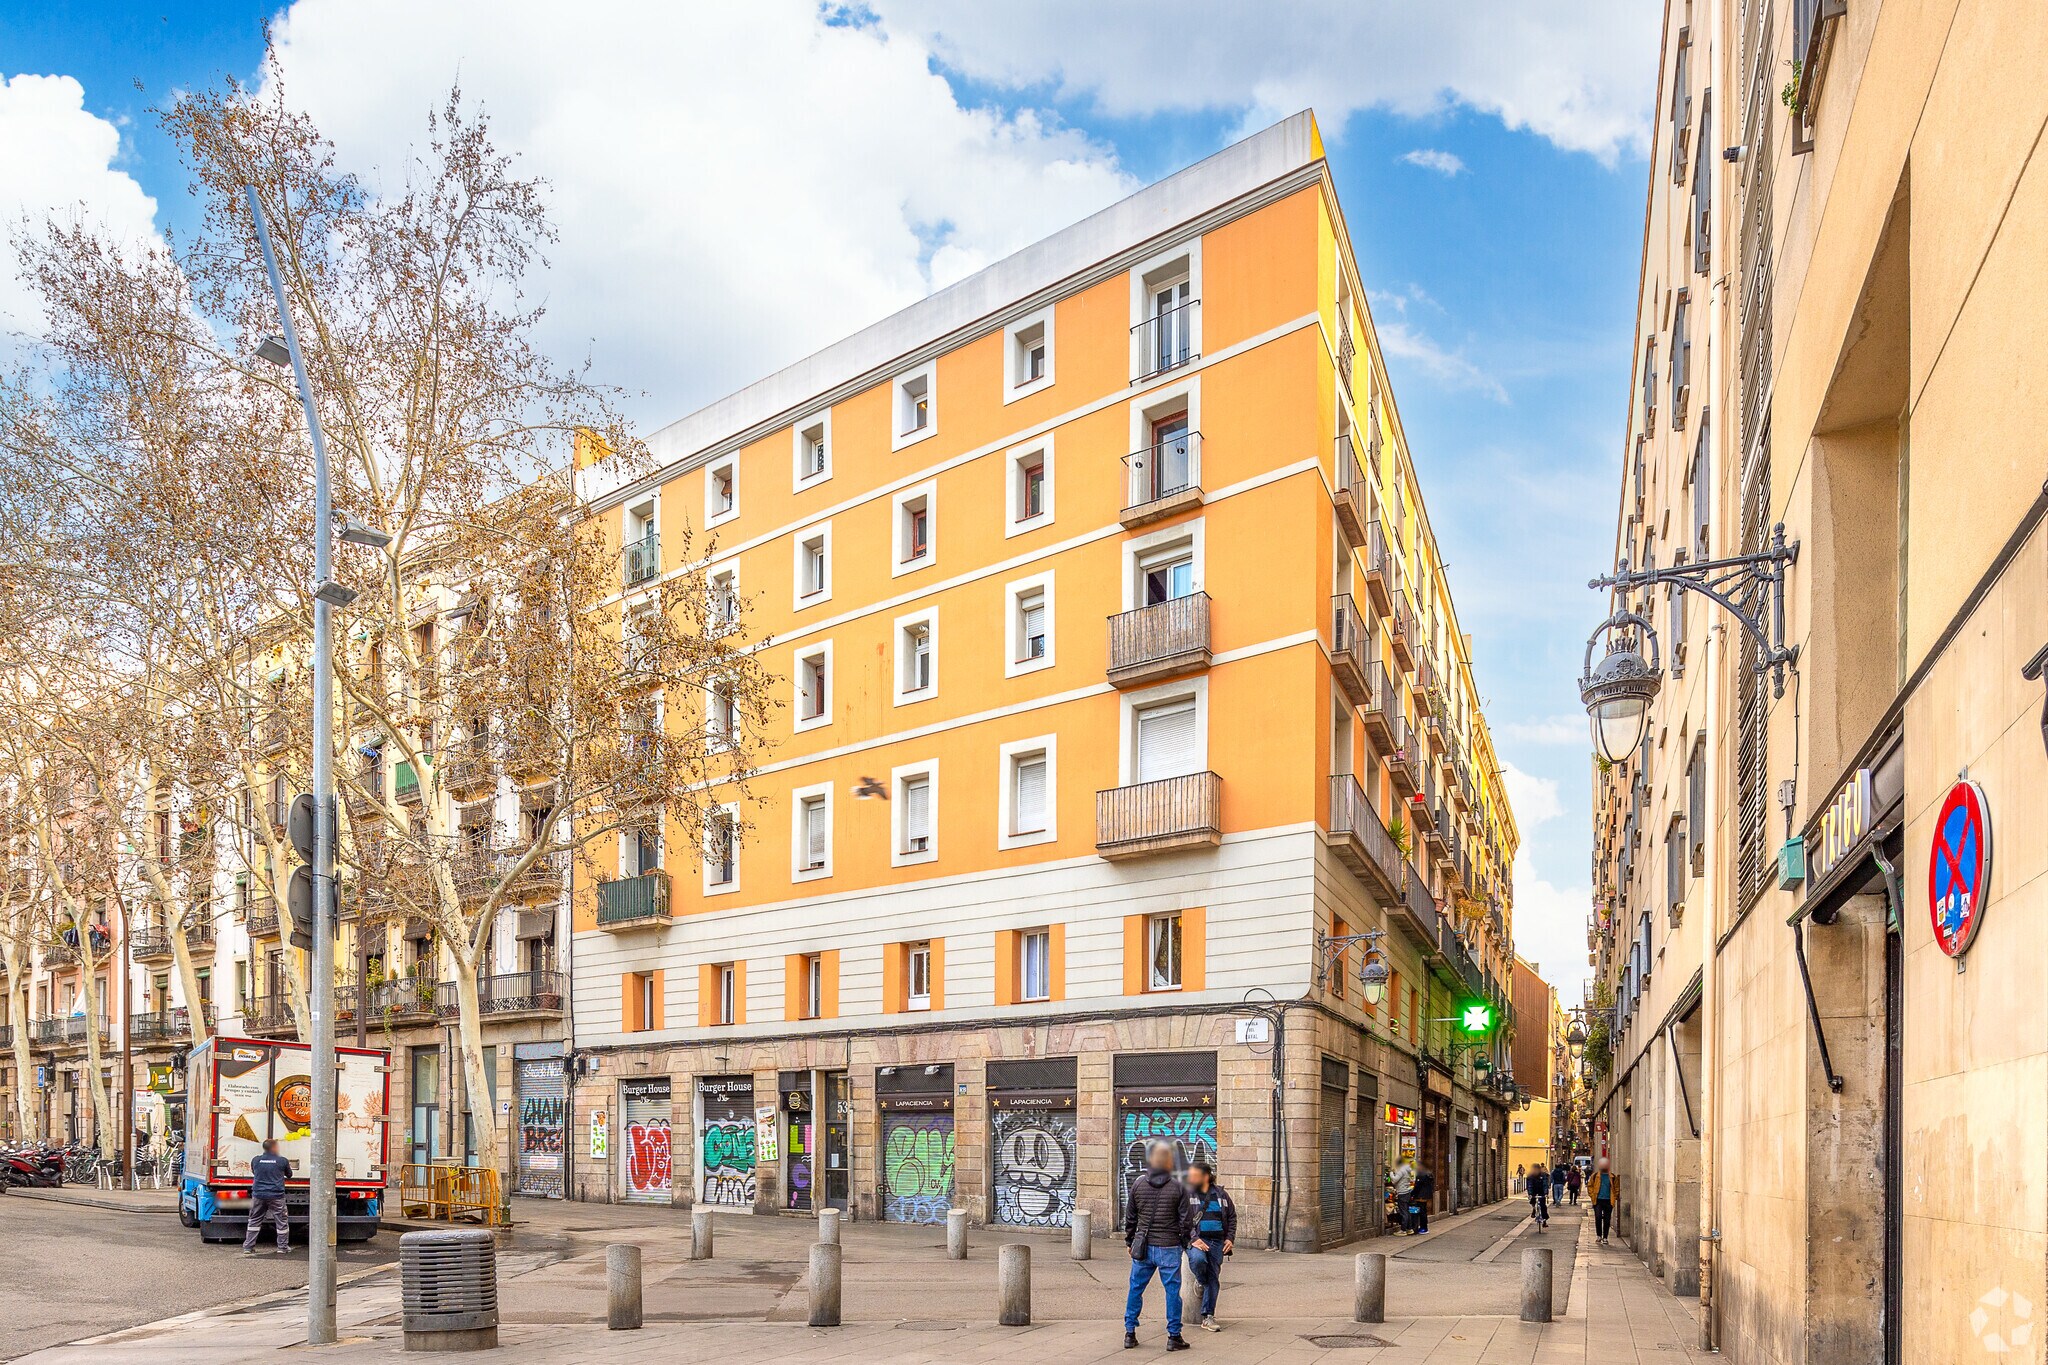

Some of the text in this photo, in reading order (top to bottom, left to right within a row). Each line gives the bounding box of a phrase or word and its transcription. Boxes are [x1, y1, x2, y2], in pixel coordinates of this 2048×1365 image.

[1821, 768, 1869, 874] TRIGO
[622, 1083, 670, 1096] Burger House
[698, 1081, 752, 1094] Burger House
[837, 1101, 848, 1114] 53
